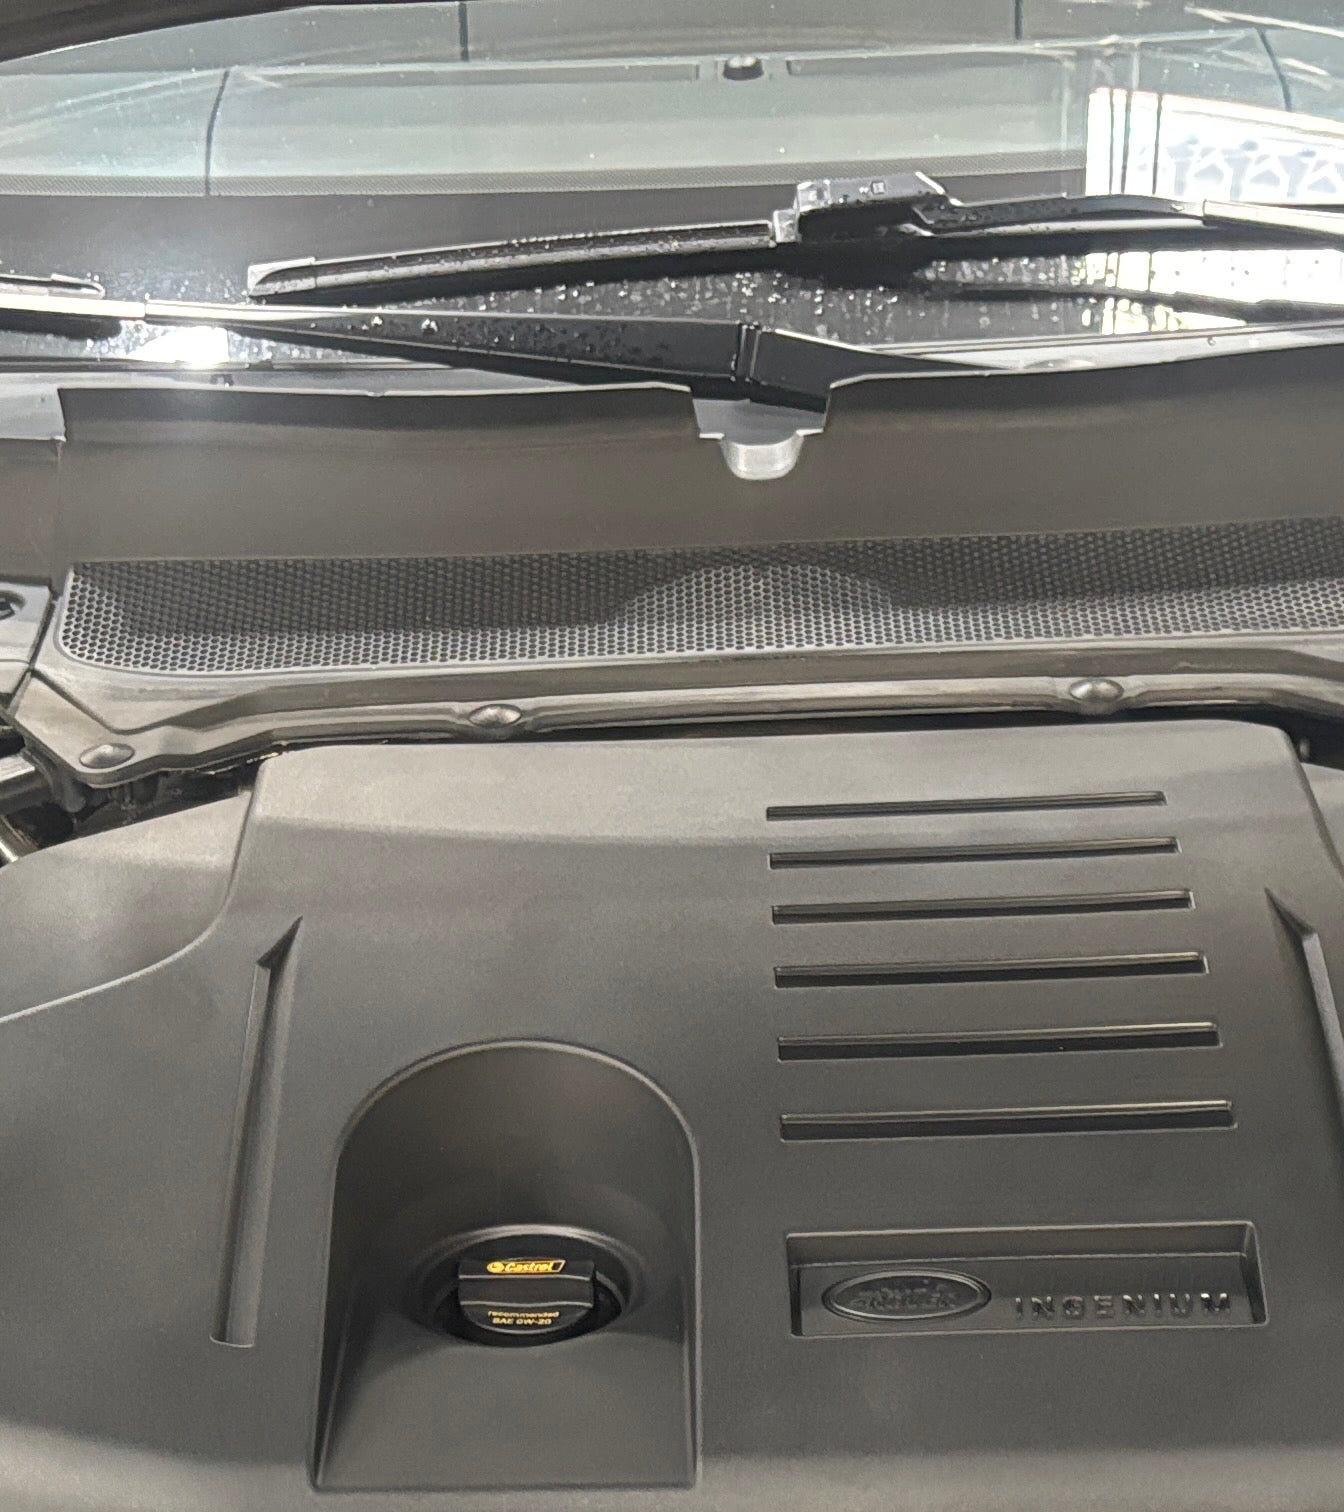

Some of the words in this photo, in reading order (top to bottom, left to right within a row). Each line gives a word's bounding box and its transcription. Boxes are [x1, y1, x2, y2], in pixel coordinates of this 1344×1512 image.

[504, 1262, 554, 1273] Castrol
[1014, 1291, 1232, 1321] INGENIUM
[487, 1310, 560, 1318] recommended
